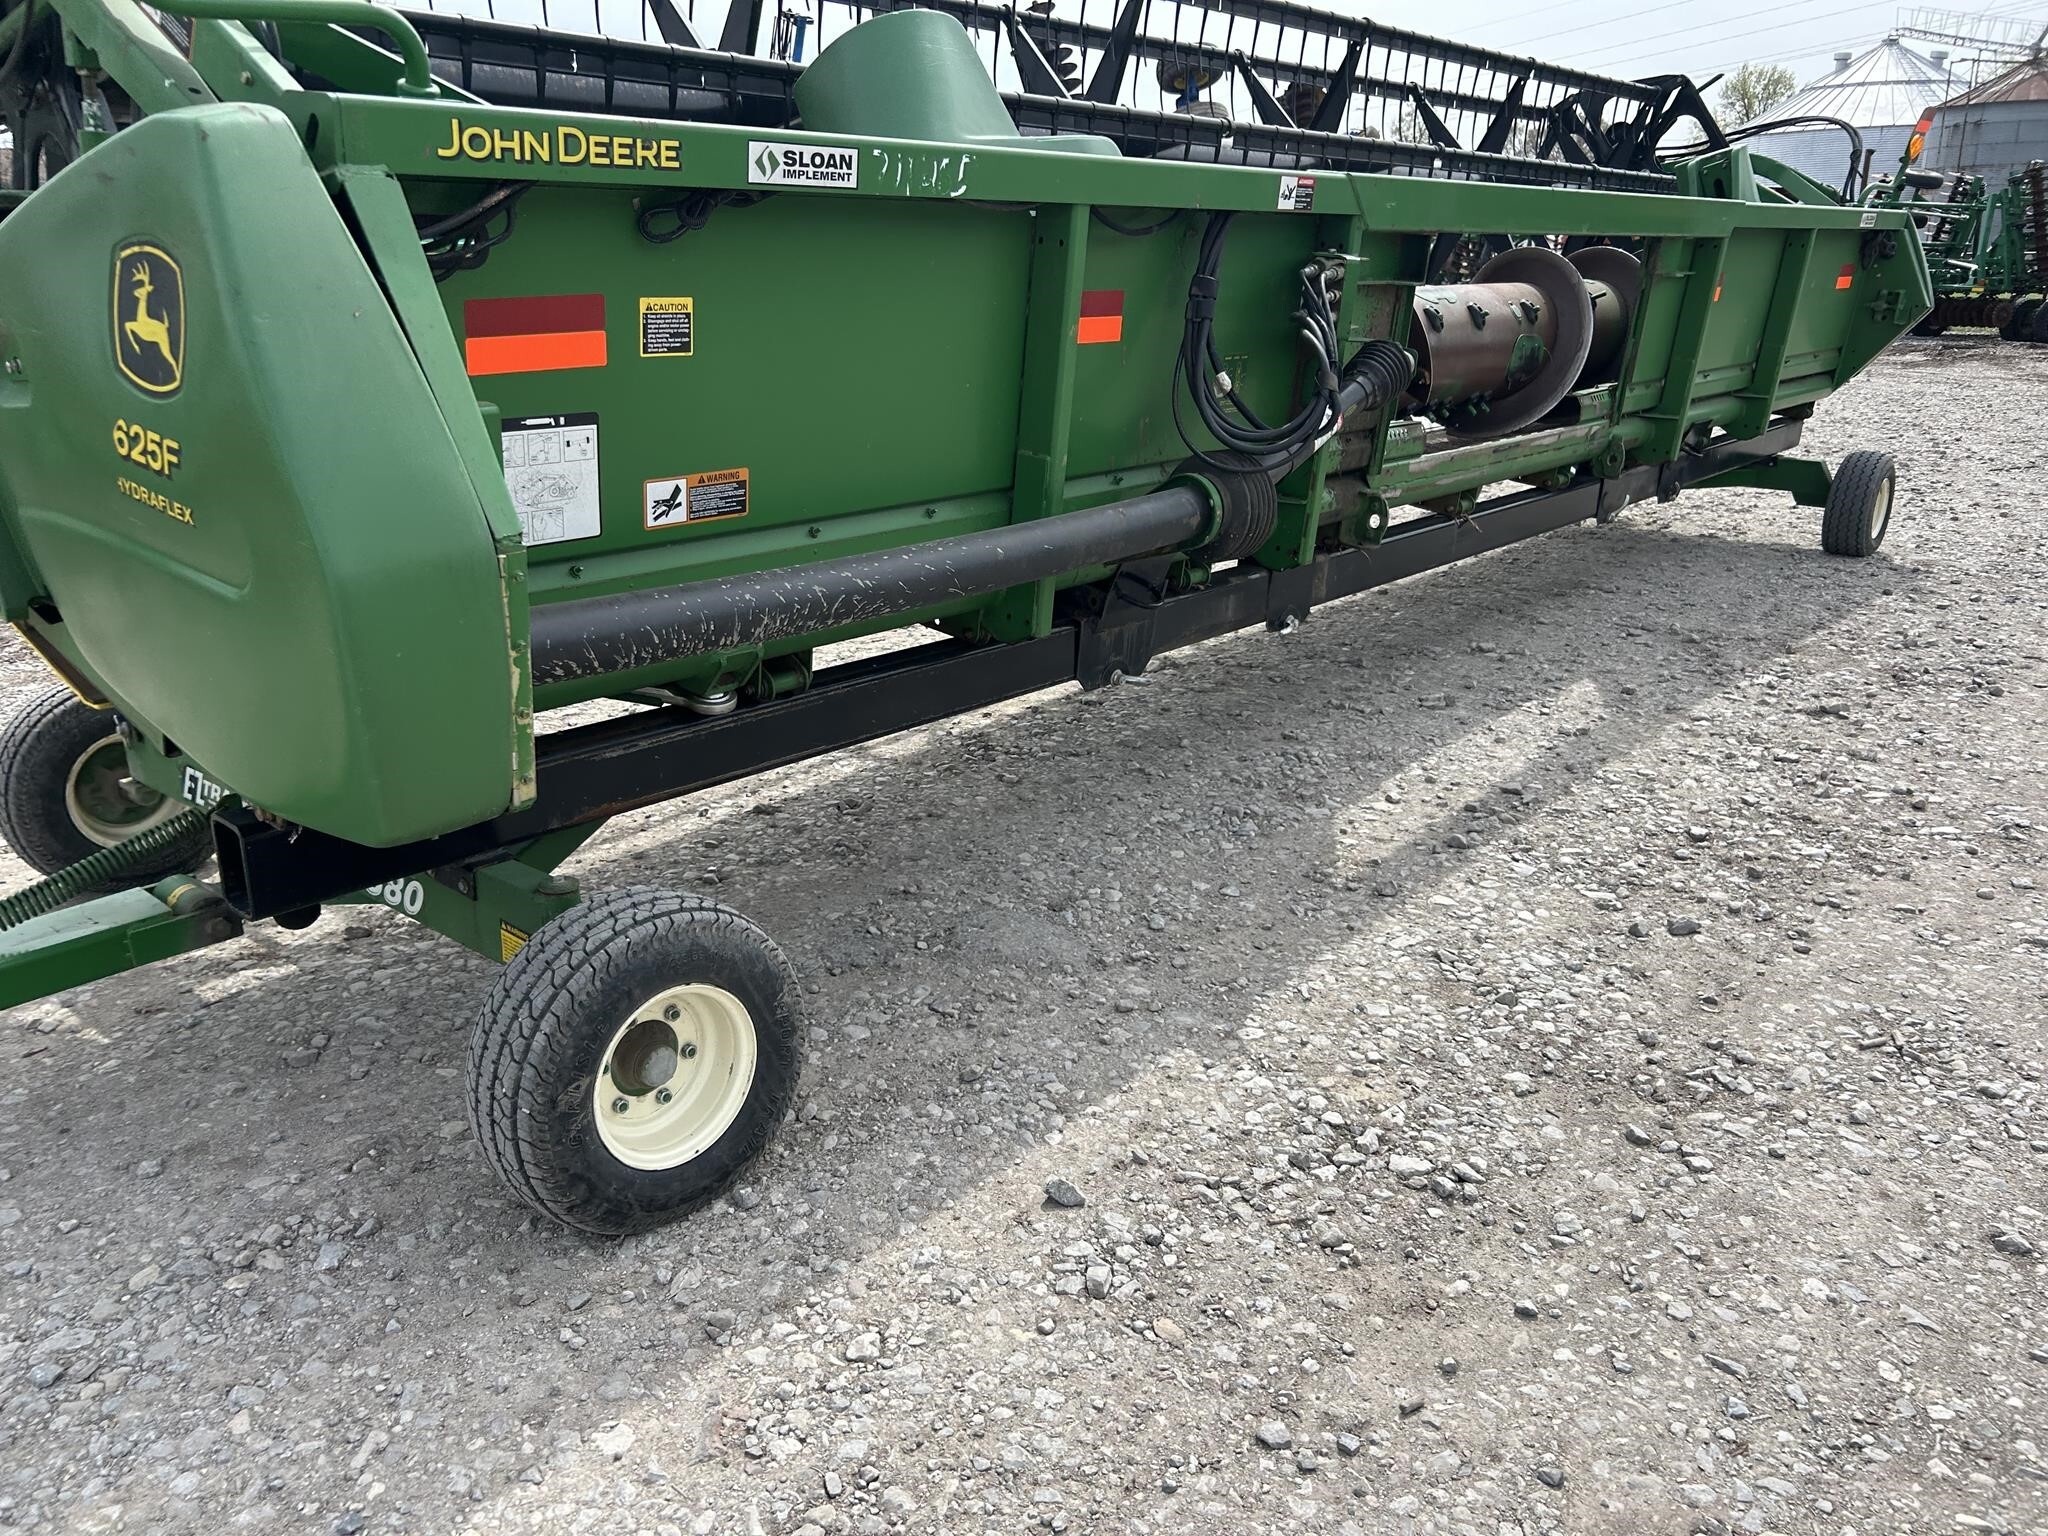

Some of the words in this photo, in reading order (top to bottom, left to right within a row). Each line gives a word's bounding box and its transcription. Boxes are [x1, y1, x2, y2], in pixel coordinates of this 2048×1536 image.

[437, 118, 550, 162] JOHN
[557, 126, 682, 170] DEERE
[782, 149, 853, 171] SLOAN
[782, 168, 853, 183] IMPLEMENT
[653, 303, 688, 311] CAUTION
[113, 418, 182, 476] 625F
[707, 471, 740, 484] WARNING
